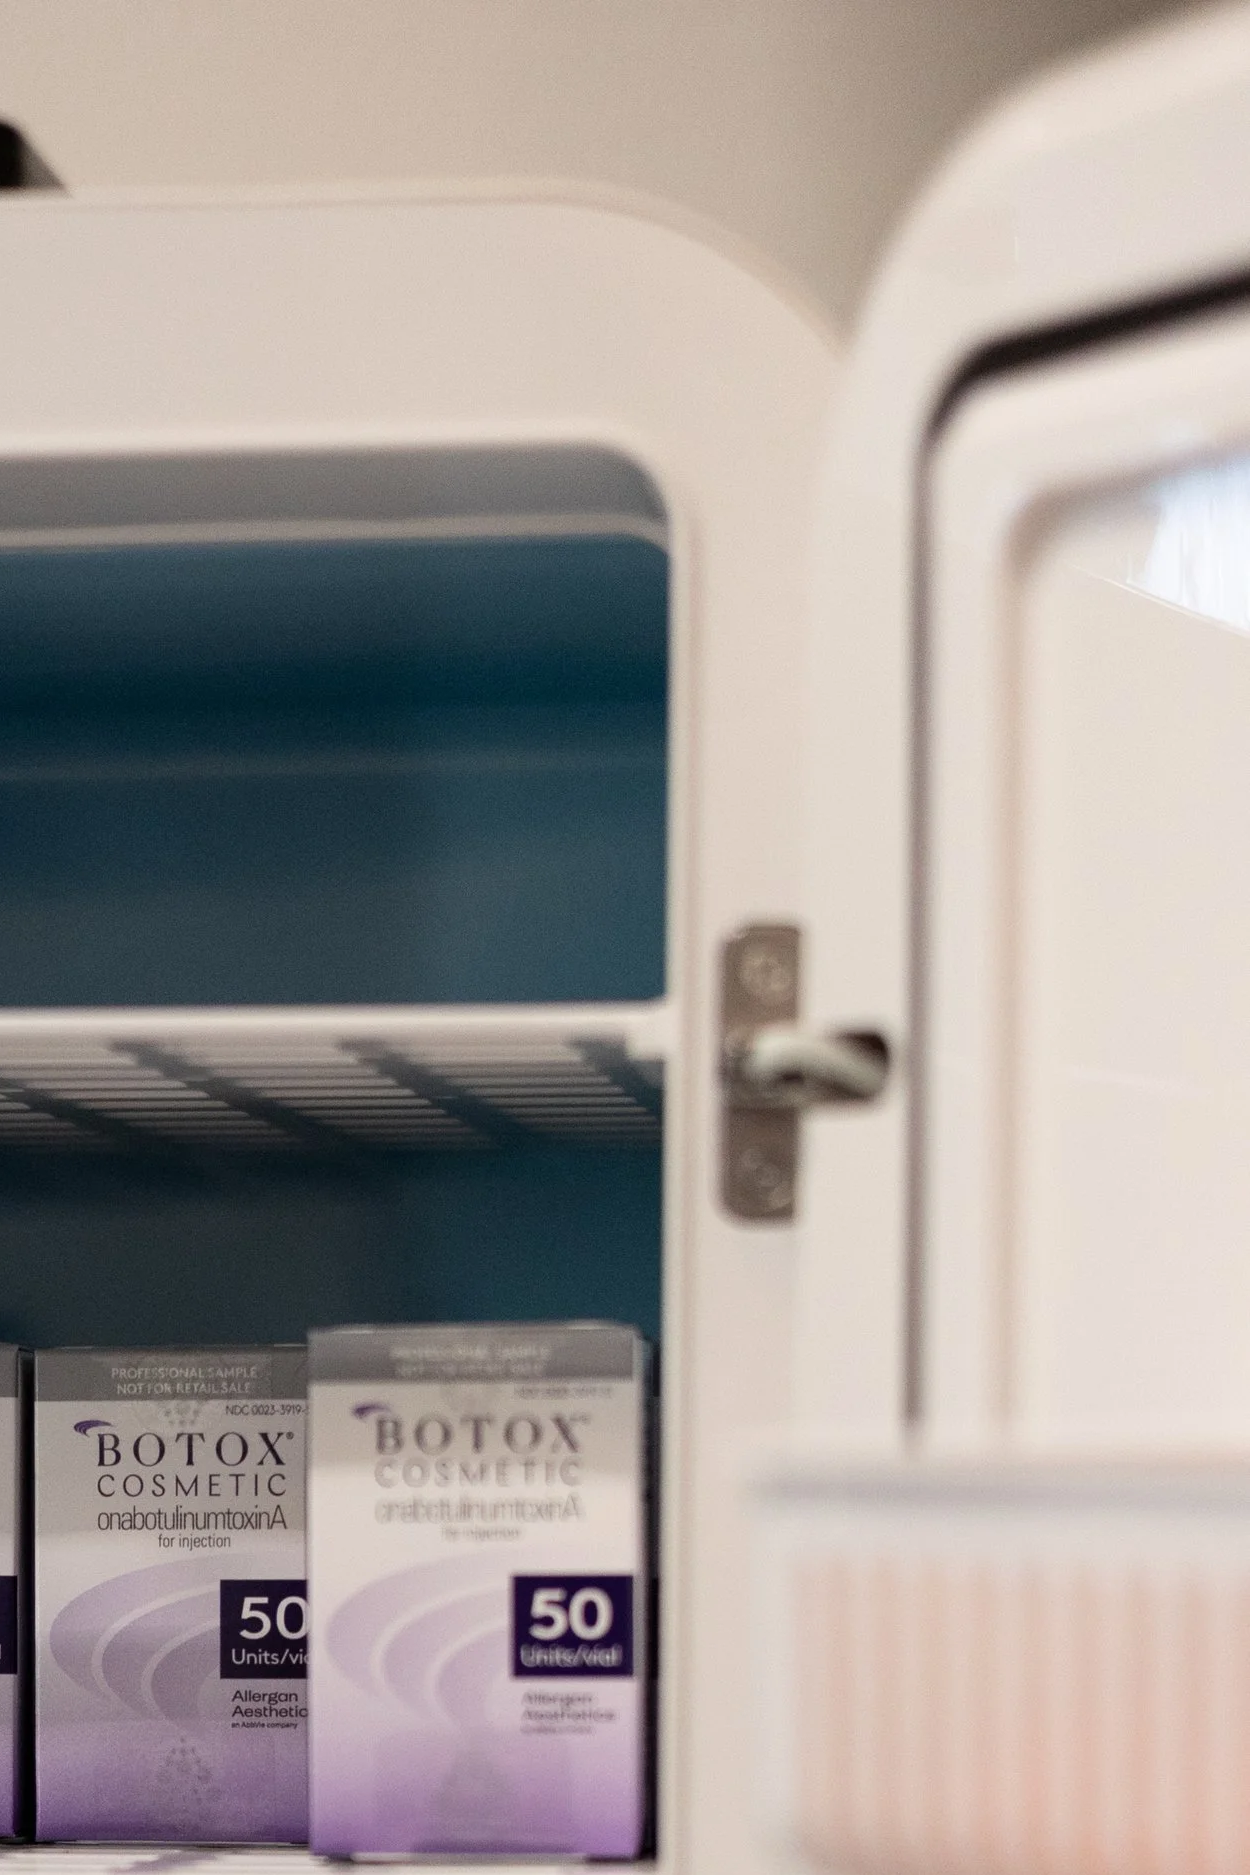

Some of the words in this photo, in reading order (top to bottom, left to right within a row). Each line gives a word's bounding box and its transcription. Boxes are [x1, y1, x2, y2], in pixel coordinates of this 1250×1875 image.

[111, 1367, 204, 1379] PROFESSIONAL
[207, 1366, 258, 1379] SAMPLE
[116, 1383, 145, 1395] NOT
[148, 1383, 173, 1395] FOR
[175, 1383, 219, 1395] RETAIL
[221, 1382, 250, 1395] SALE
[225, 1404, 249, 1416] NDC
[251, 1404, 308, 1416] 0023-3919-
[374, 1457, 585, 1488] COSMETIC
[97, 1473, 287, 1497] COSMETIC
[97, 1504, 288, 1531] onabotulinumtoxinA
[158, 1533, 175, 1548] for
[178, 1534, 231, 1551] injection
[239, 1596, 309, 1640] 50
[529, 1587, 614, 1641] 50
[520, 1643, 623, 1668] Units/vial
[231, 1690, 298, 1706] Allergan
[231, 1705, 308, 1718] Aesthetic
